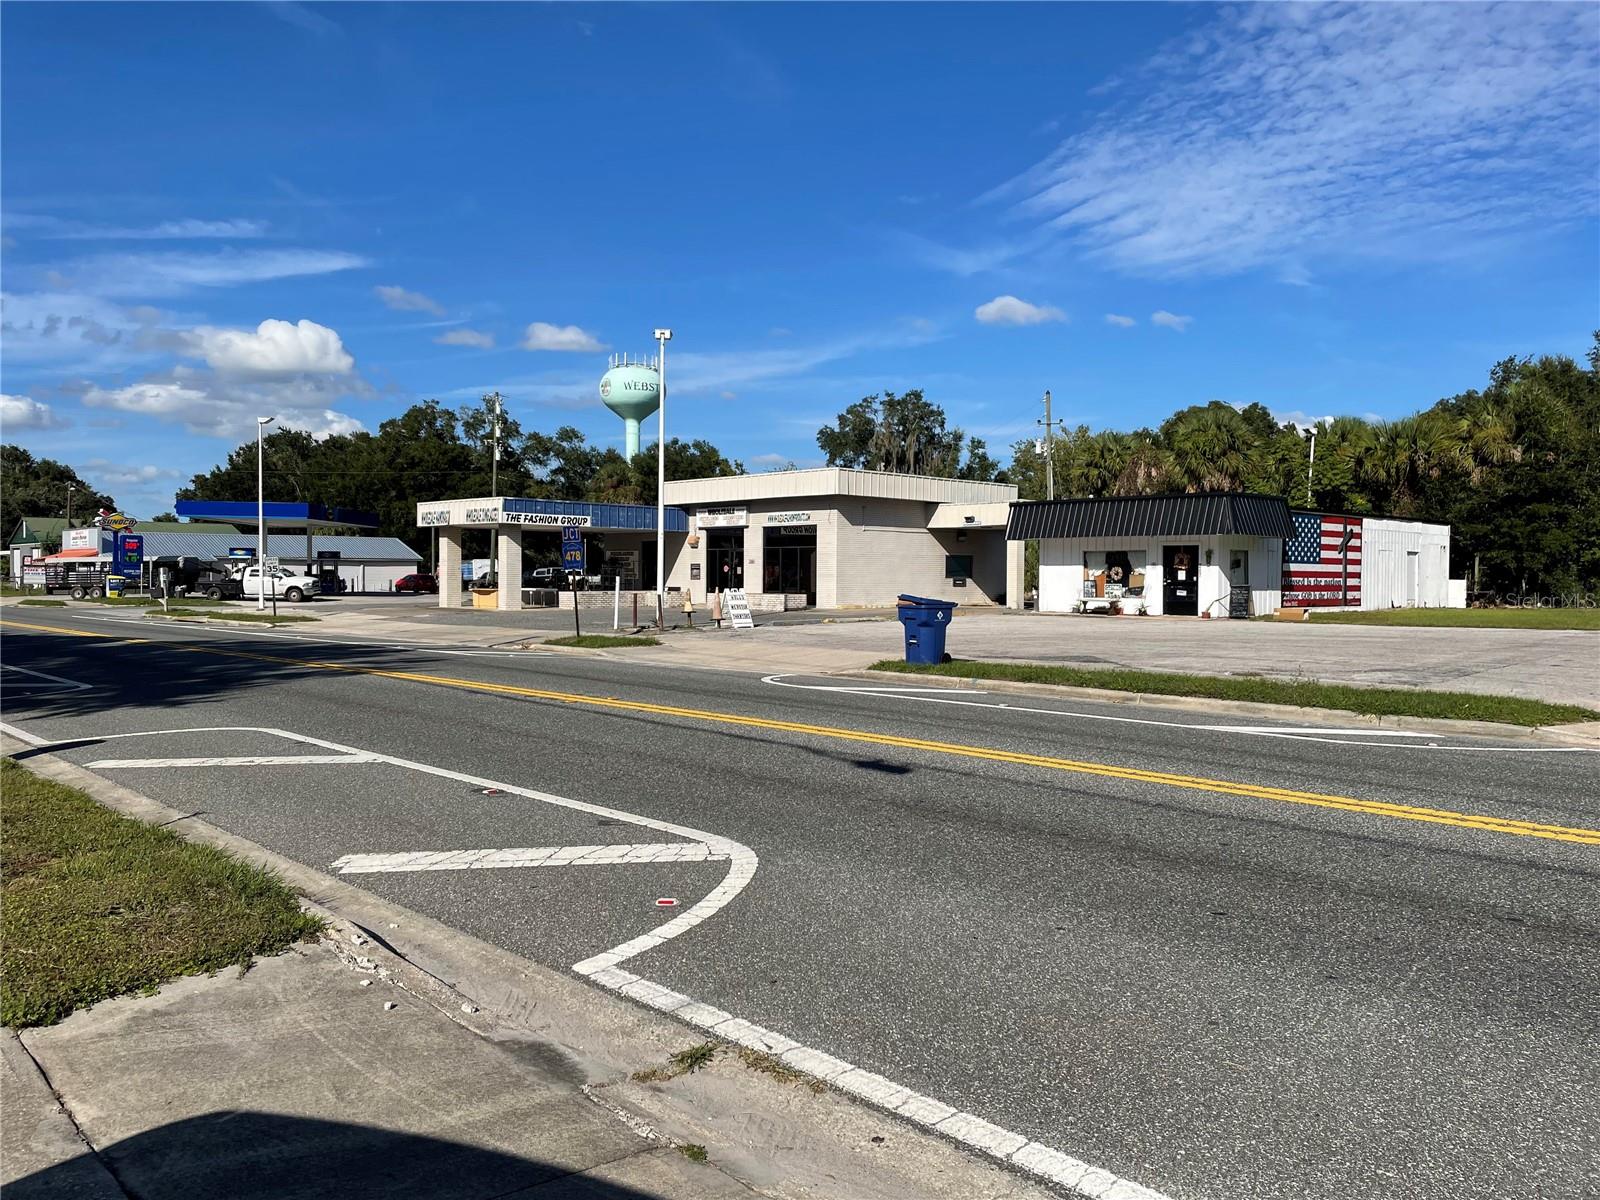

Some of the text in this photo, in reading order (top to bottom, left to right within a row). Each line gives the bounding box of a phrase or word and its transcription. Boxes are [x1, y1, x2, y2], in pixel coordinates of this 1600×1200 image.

[102, 518, 136, 527] SUNOCO
[506, 513, 522, 523] THE
[523, 515, 559, 525] FASHION
[560, 516, 588, 526] GROUP
[564, 528, 579, 540] JCT
[565, 550, 581, 561] 478
[267, 565, 278, 573] 35
[1314, 578, 1323, 586] the
[1324, 578, 1342, 586] nation
